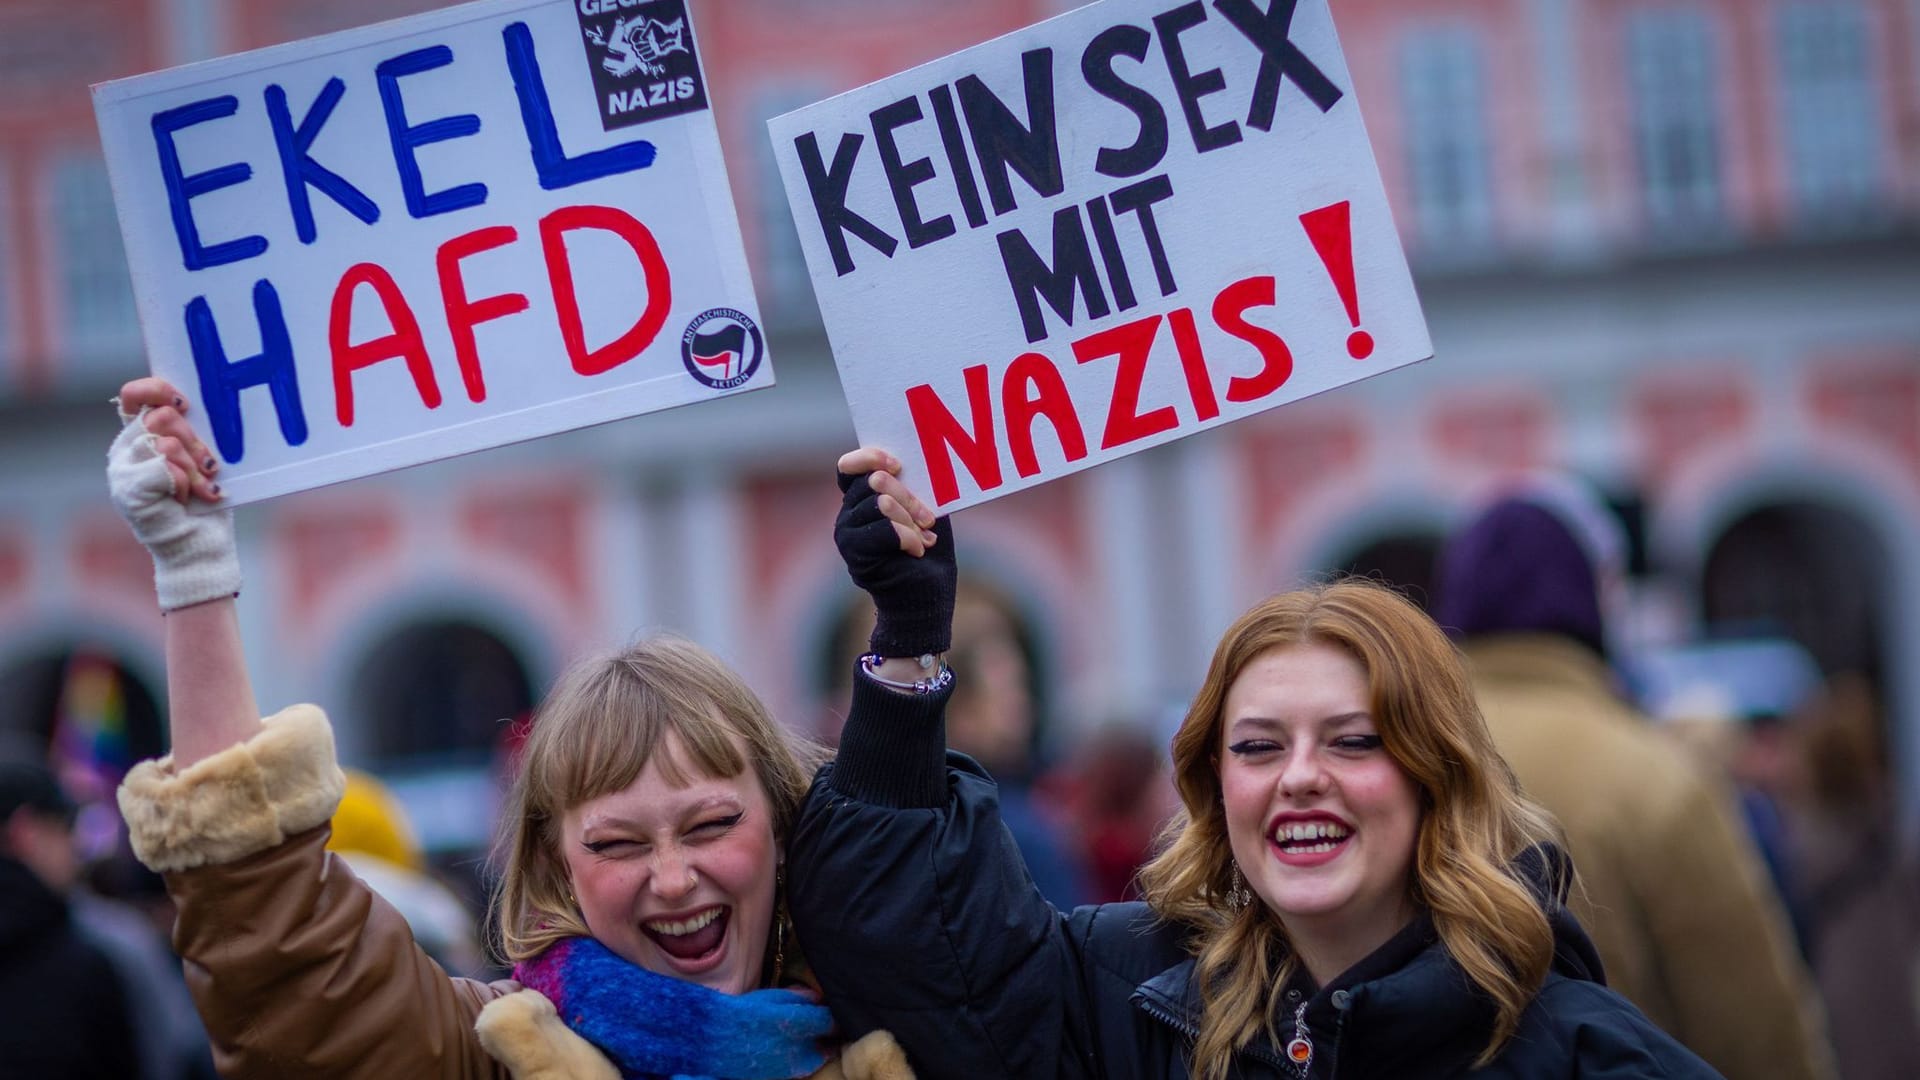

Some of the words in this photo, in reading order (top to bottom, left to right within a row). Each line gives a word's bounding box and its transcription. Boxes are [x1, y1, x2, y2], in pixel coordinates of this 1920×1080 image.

[151, 21, 658, 271] EKEL
[608, 76, 695, 116] NAZIS
[795, 47, 1064, 277] KEIN
[1081, 0, 1344, 177] SEX
[184, 205, 672, 465] HAFD
[996, 174, 1177, 344] MIT
[711, 372, 749, 389] AKTION
